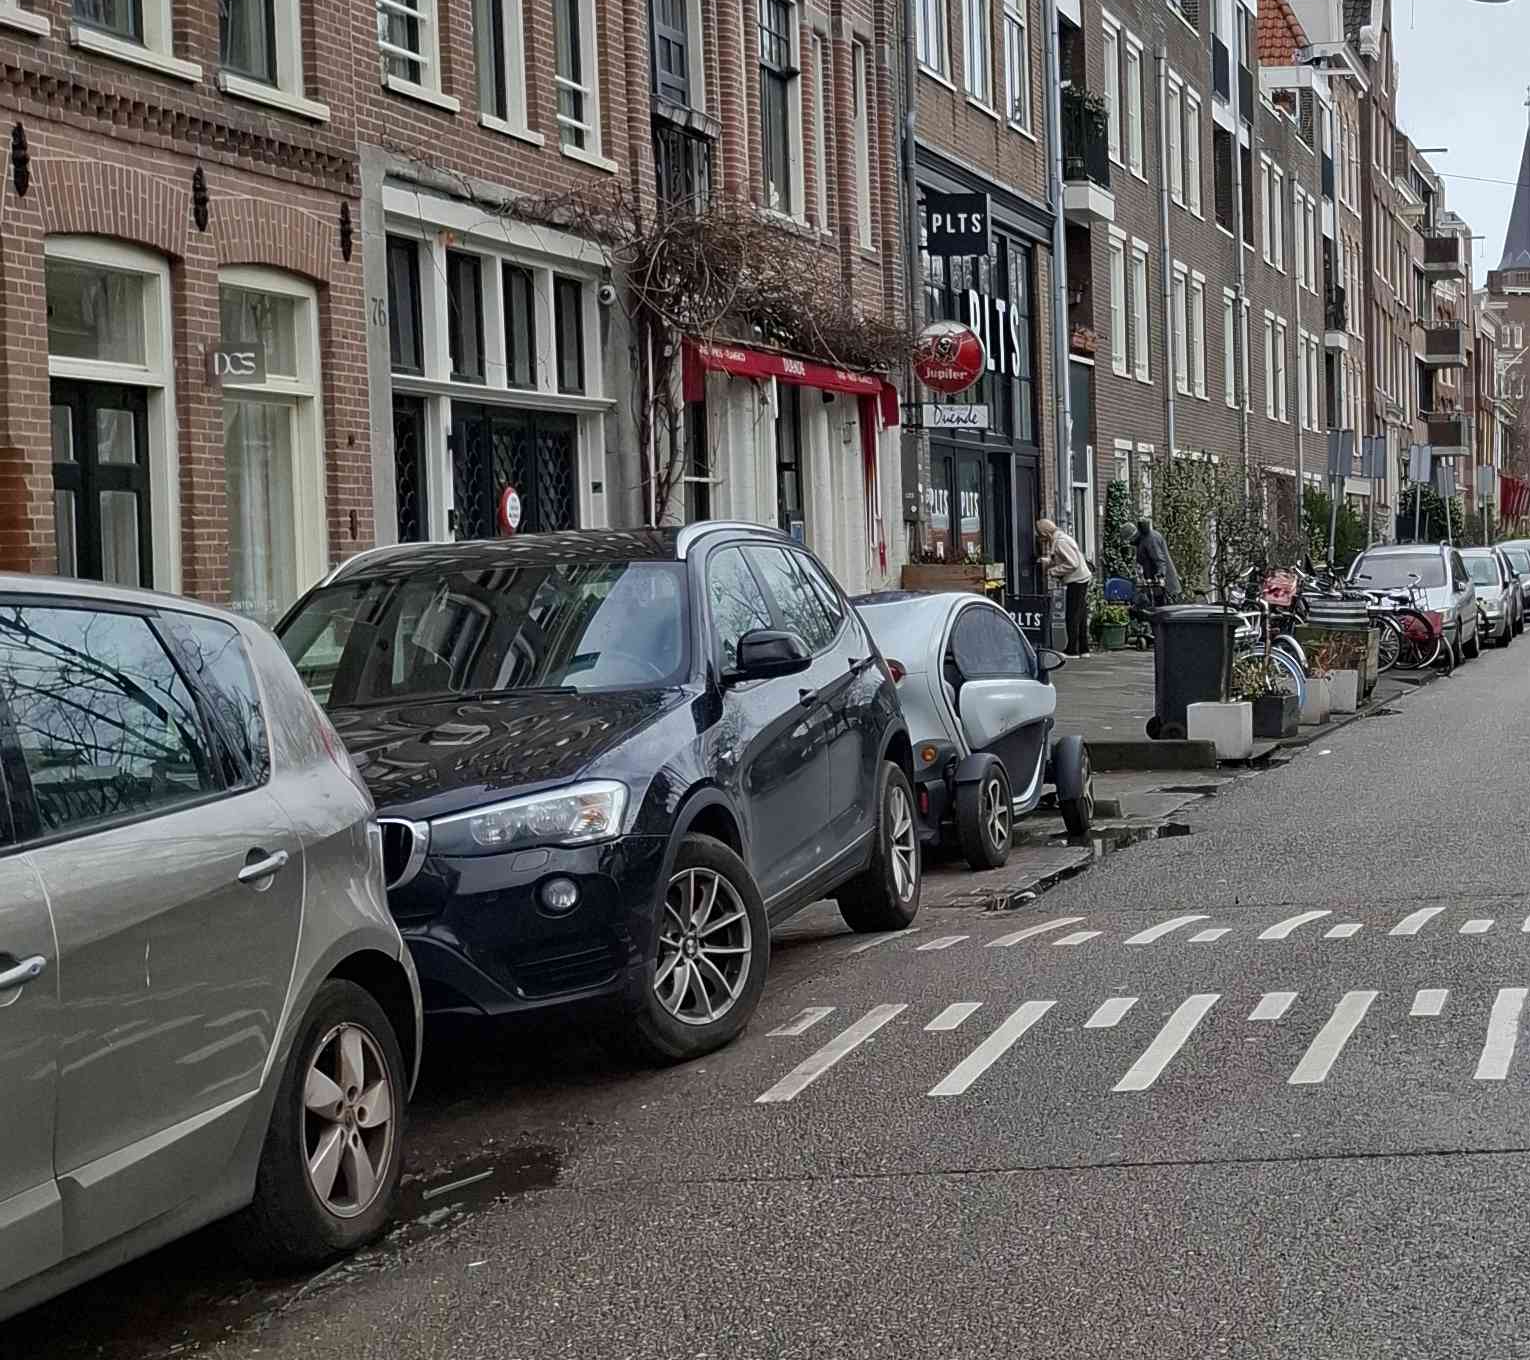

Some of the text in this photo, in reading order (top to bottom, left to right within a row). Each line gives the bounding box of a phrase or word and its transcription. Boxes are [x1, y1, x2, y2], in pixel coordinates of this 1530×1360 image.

[932, 213, 982, 233] PLTS
[371, 297, 386, 328] 76
[969, 289, 1020, 378] PLTS
[214, 352, 256, 376] DCS
[924, 367, 968, 381] Jupiler
[934, 403, 978, 425] Duende
